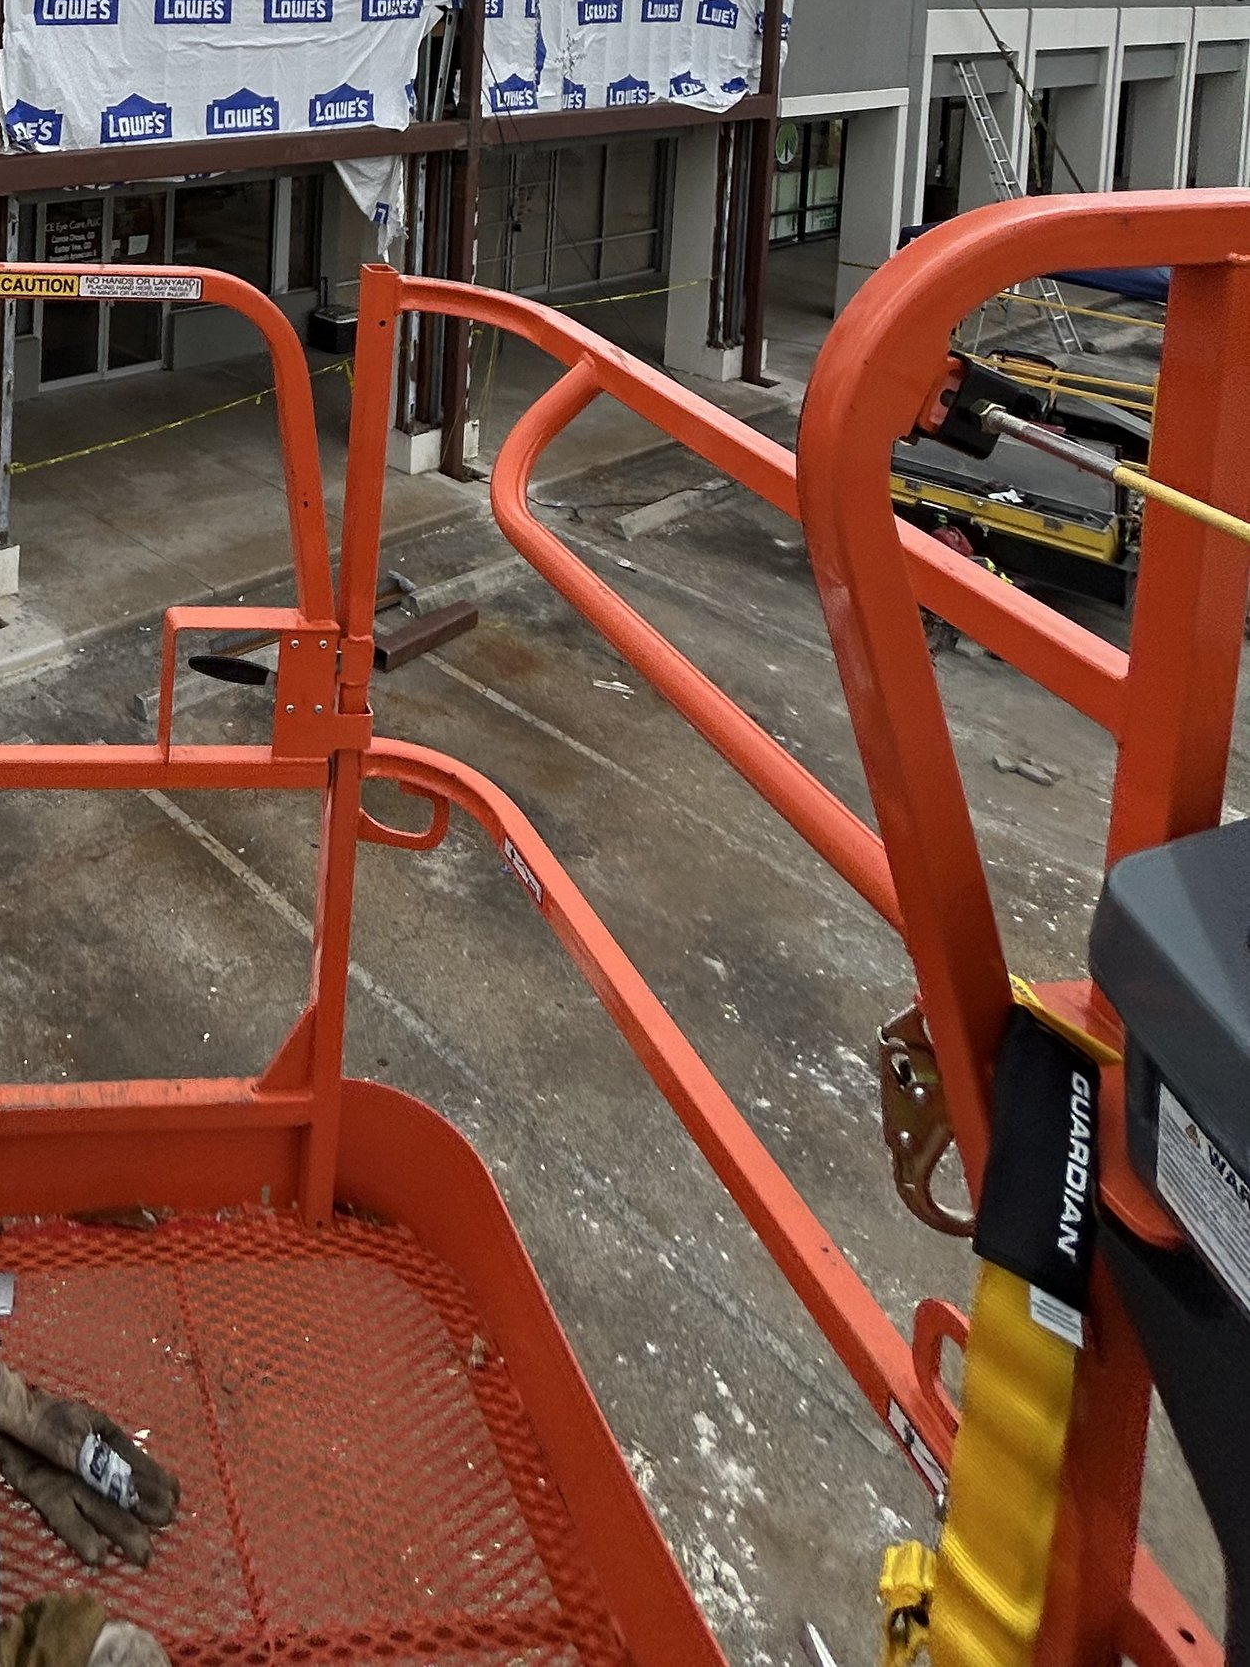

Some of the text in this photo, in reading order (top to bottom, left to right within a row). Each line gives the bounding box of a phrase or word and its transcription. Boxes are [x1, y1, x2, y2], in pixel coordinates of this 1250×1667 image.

[213, 104, 273, 129] LOWE'S
[315, 97, 368, 122] LOWE'S
[109, 111, 165, 138] LOWE'S
[0, 275, 75, 294] CAUTION
[102, 277, 134, 285] HANDS
[136, 277, 151, 285] OR
[153, 278, 196, 286] LANYARD
[1057, 1070, 1091, 1264] GUARDIAN
